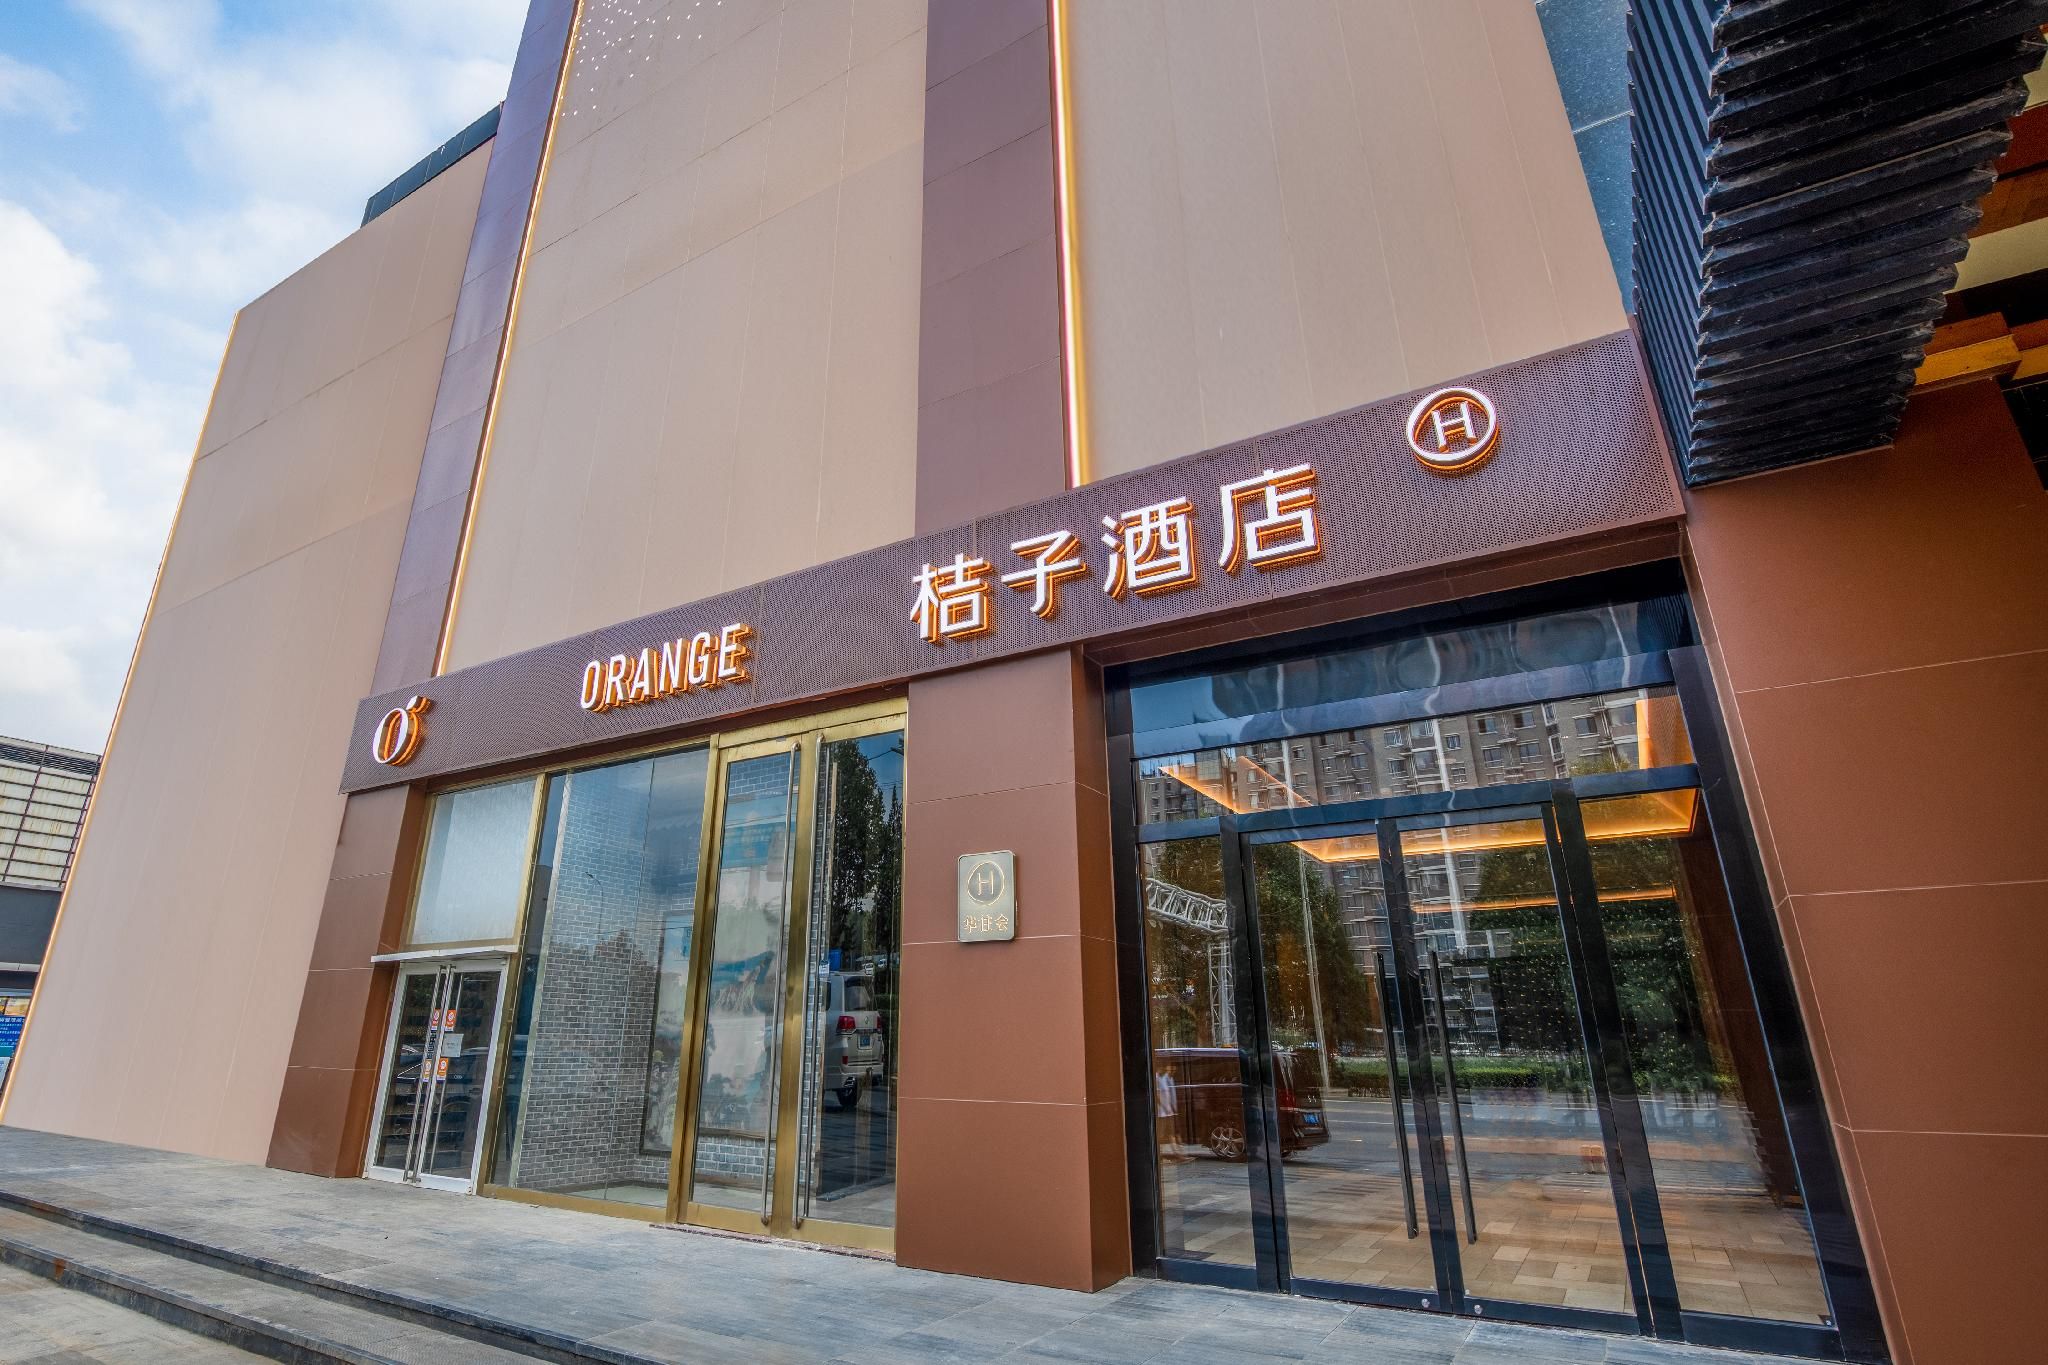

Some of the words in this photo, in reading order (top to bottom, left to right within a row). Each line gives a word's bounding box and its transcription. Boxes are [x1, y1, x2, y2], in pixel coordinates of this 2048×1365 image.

[911, 464, 1319, 642] 桔子酒店
[580, 623, 750, 711] ORANGE
